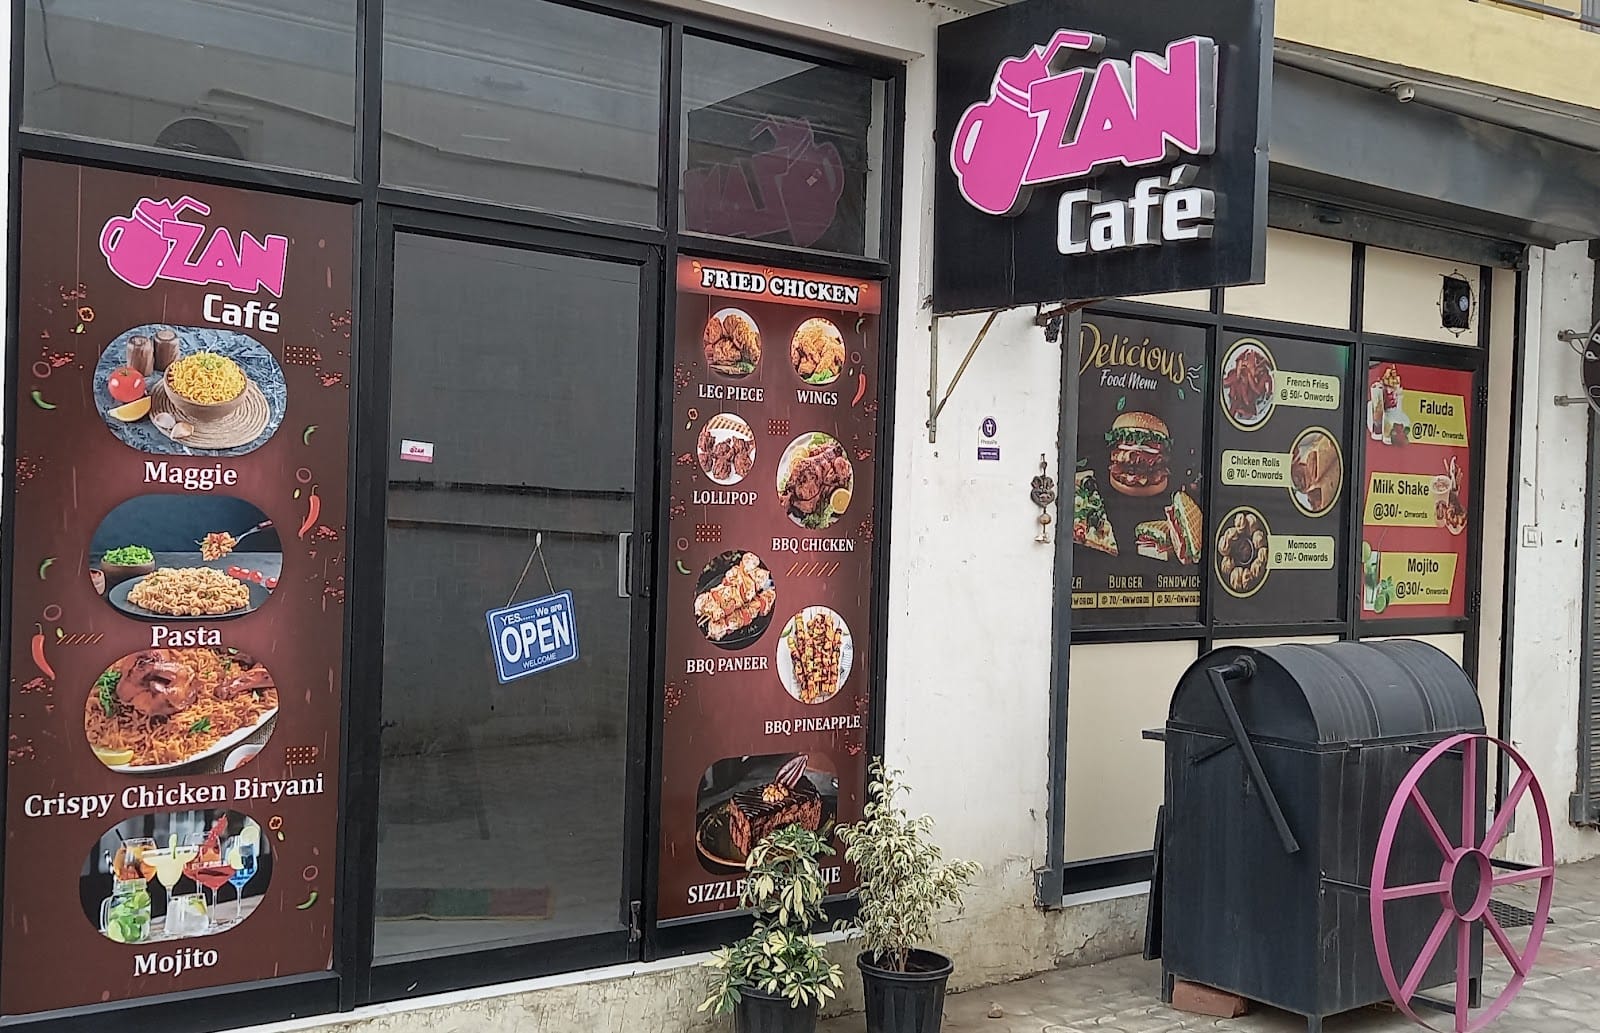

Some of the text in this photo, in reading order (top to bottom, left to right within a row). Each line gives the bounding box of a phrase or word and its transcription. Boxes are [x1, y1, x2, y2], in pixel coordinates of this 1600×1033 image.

[1057, 165, 1202, 255] Café
[701, 268, 860, 304] FRIED CHICKEN
[203, 293, 281, 333] Café
[1079, 323, 1185, 384] Delicious
[1100, 369, 1158, 390] Food Menu
[1286, 377, 1329, 390] French Fries
[698, 384, 765, 402] LEG PIECE
[796, 389, 839, 406] WINGS
[1420, 399, 1454, 417] Faluda
[1230, 455, 1280, 467] Chicken Rolls
[143, 461, 239, 490] Maggie
[1373, 478, 1430, 496] Milk Shake
[692, 491, 758, 506] LOLLIPOP
[771, 537, 855, 553] BBQ CHICKEN
[1407, 558, 1439, 576] Mojito
[1109, 575, 1143, 589] BURGER
[150, 625, 222, 648] Pasta
[500, 611, 571, 664] OPEN
[522, 652, 557, 669] WELCOME
[686, 656, 768, 675] BBQ PANEER
[764, 715, 861, 735] BBQ PINEAPPLE
[23, 772, 324, 819] Crispy Chicken Biryani
[132, 947, 218, 977] Mojito
